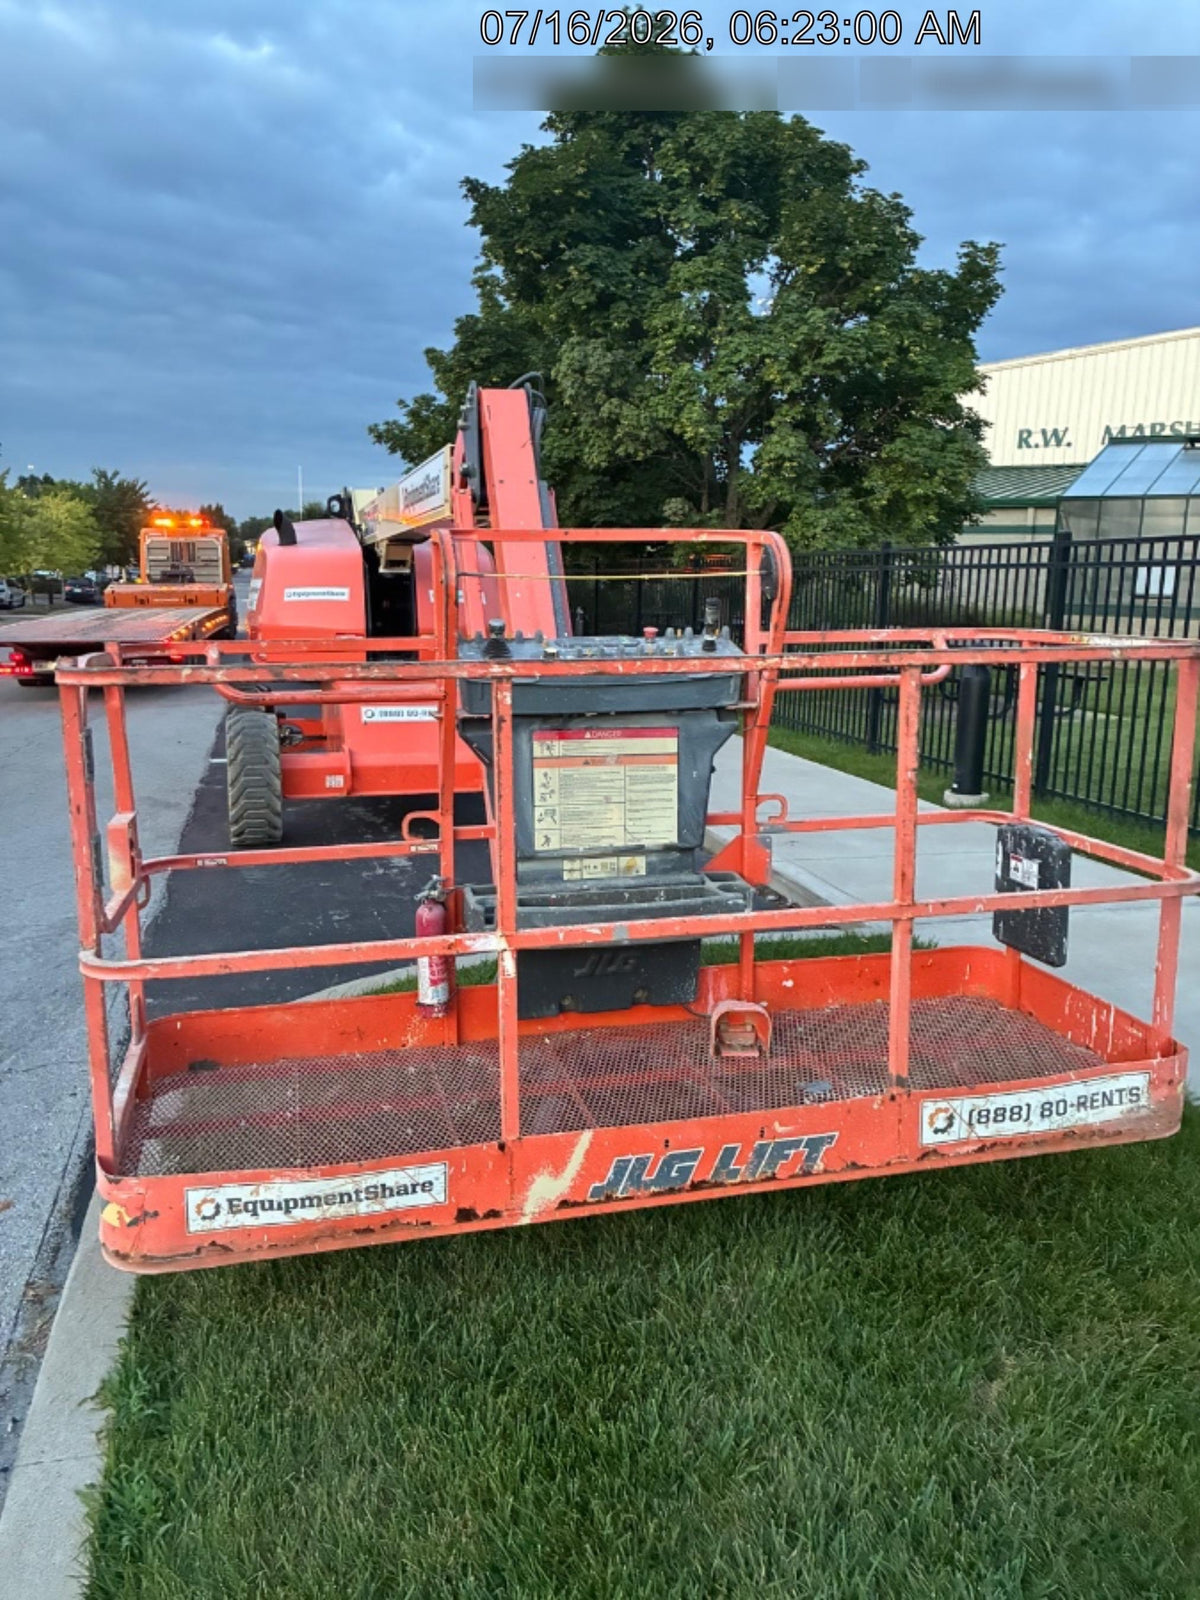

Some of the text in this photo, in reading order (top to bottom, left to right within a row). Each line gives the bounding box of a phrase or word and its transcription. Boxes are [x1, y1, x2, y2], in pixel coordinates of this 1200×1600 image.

[1017, 427, 1072, 449] R.W.
[967, 1086, 1142, 1126] (888) 80-RENTS
[587, 1131, 839, 1201] JLG LIFT
[226, 1178, 434, 1217] EquipmentShare
